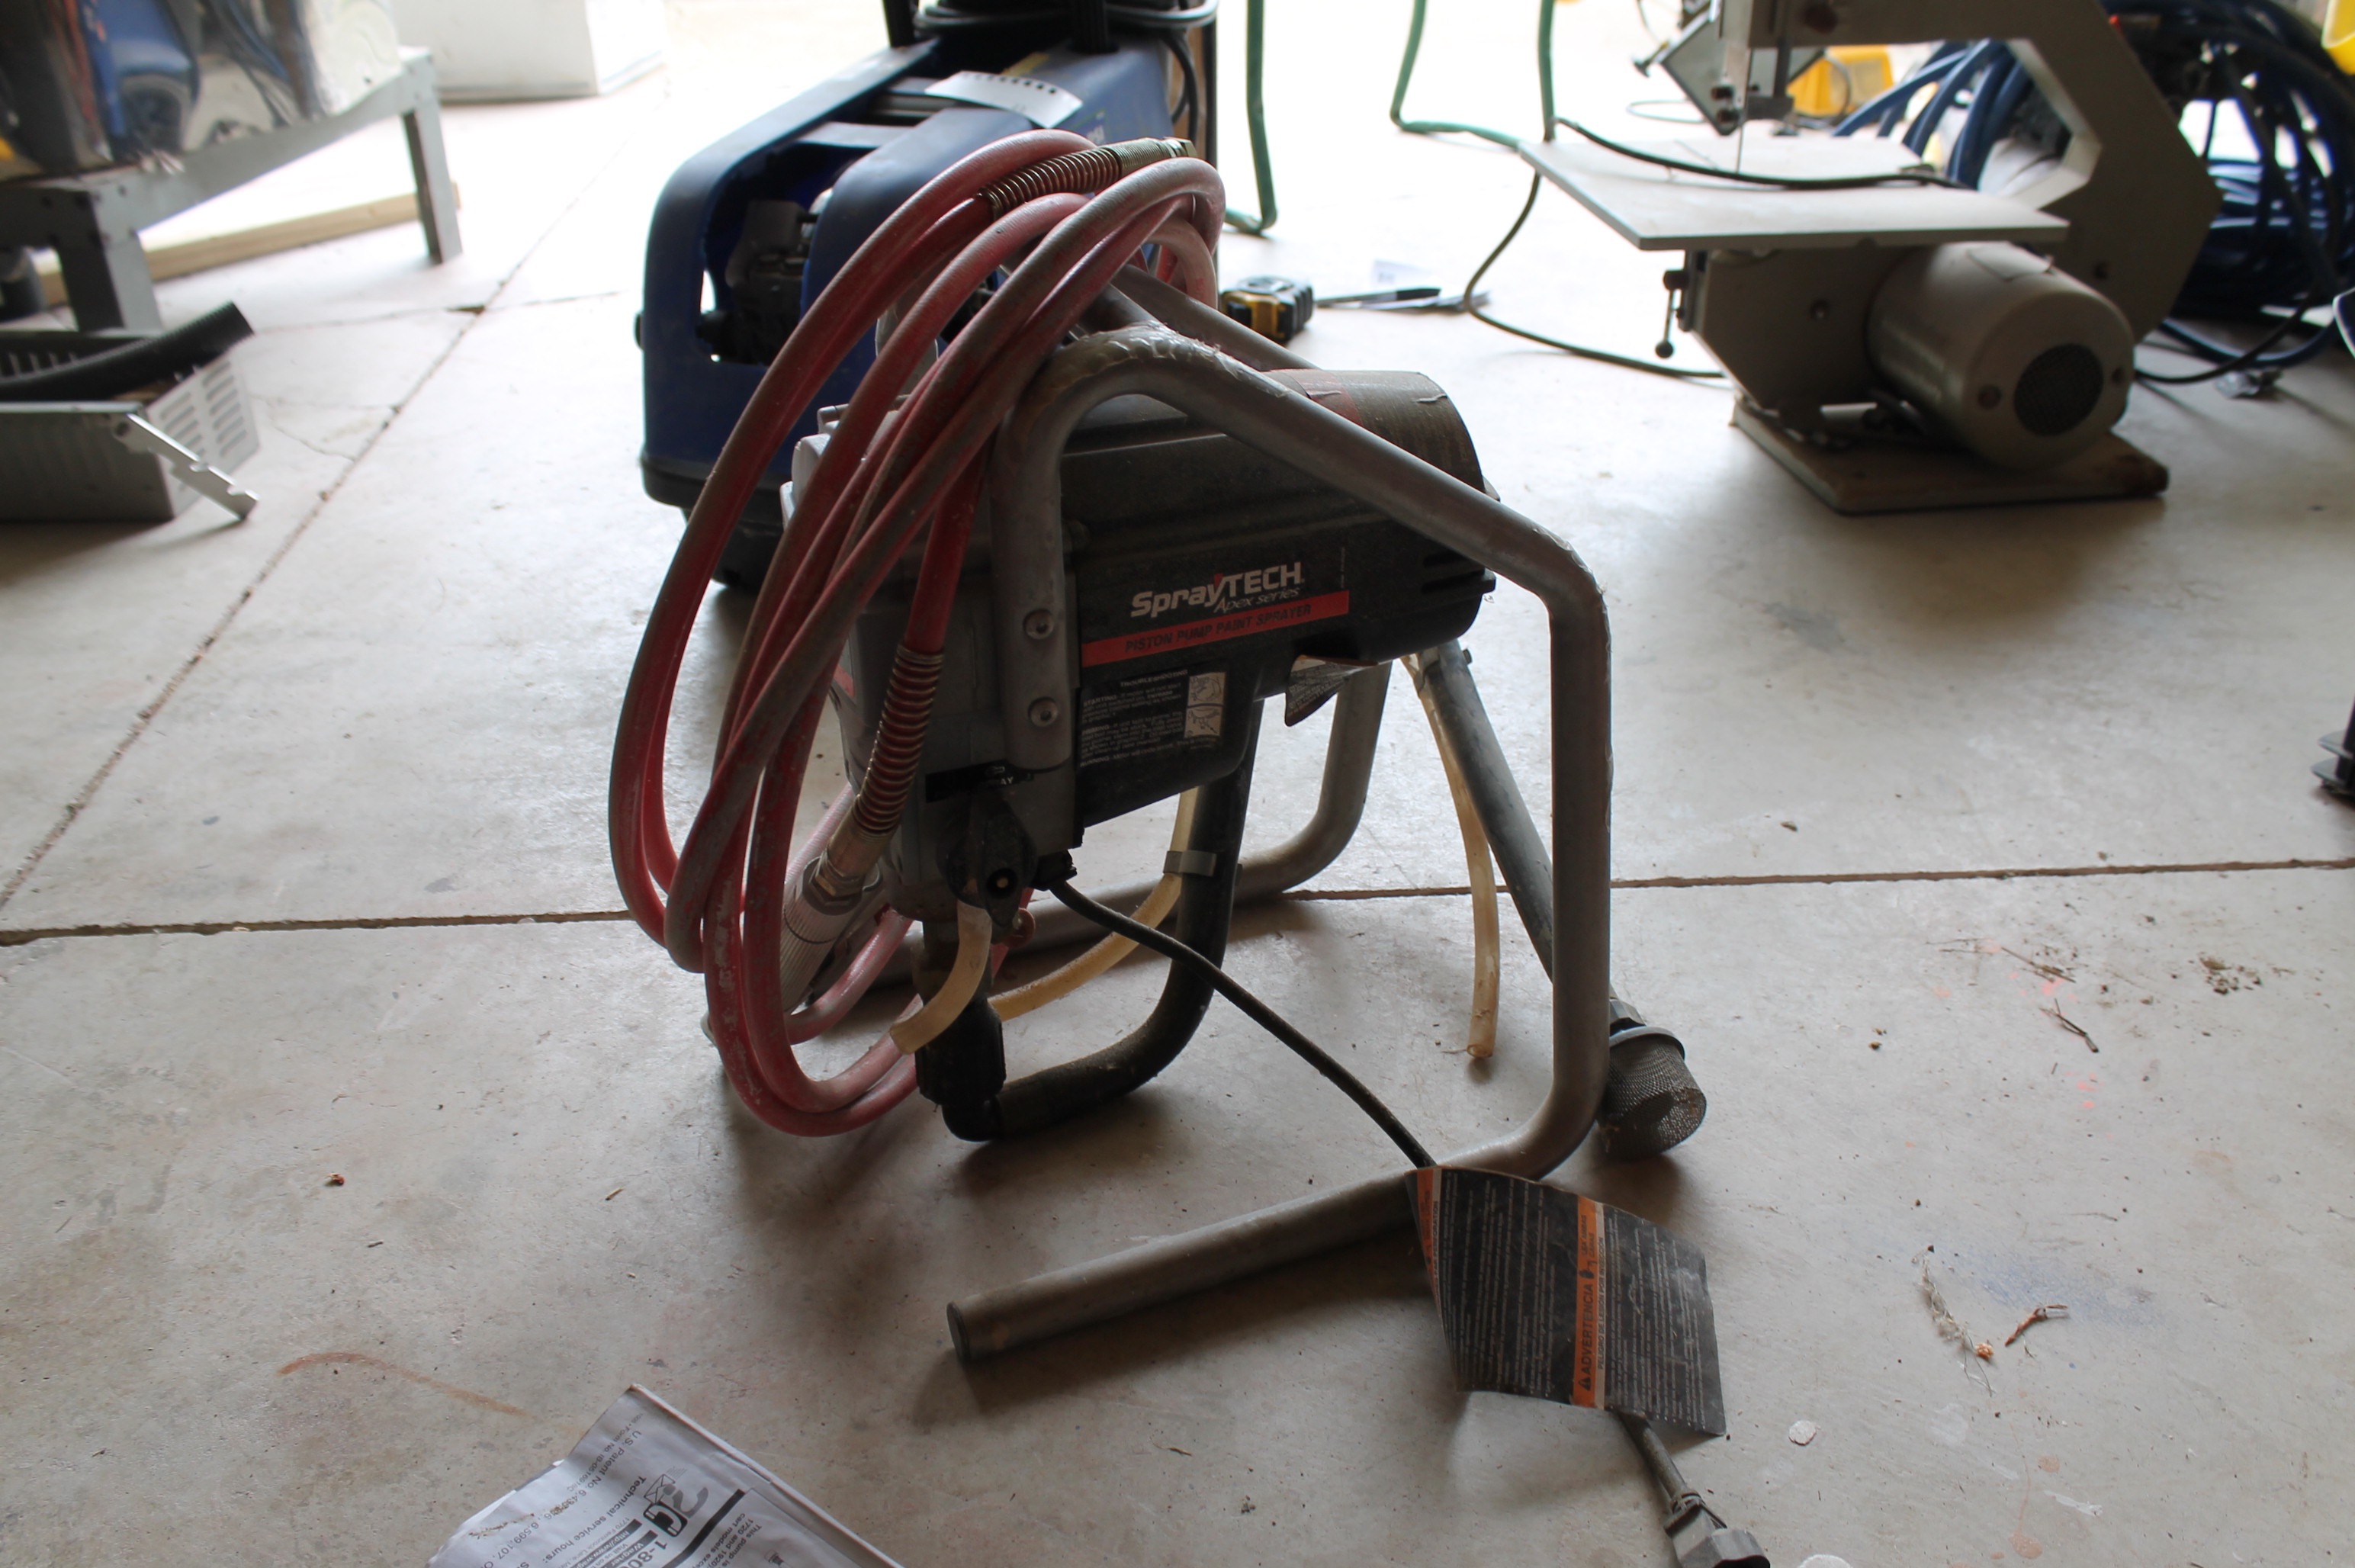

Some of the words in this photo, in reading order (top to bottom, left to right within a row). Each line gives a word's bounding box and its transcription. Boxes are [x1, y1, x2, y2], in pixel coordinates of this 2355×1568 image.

[1214, 596, 1251, 613] Apex
[1255, 587, 1299, 603] series
[1125, 632, 1172, 652] PISTON
[1177, 625, 1212, 642] PUMP
[1216, 616, 1251, 634] PAINT
[1256, 604, 1311, 625] SPRAYER
[1580, 1284, 1592, 1374] ADVERTENCIA
[1598, 1323, 1604, 1333] DE
[612, 1425, 630, 1442] Form
[622, 1429, 641, 1447] U.S.
[598, 1446, 625, 1475] Patent
[584, 1475, 601, 1490] No.
[606, 1474, 646, 1517] Technical
[573, 1515, 606, 1541] service
[614, 1516, 629, 1529] 1770
[731, 1512, 745, 1527] cart
[737, 1518, 753, 1534] 1720
[710, 1526, 733, 1553] models
[745, 1524, 762, 1537] This
[724, 1534, 737, 1549] and
[727, 1537, 747, 1559] pump
[541, 1539, 573, 1563] hours:
[610, 1541, 644, 1566] Wagner
[595, 1558, 605, 1566] on
[721, 1559, 730, 1567] is
